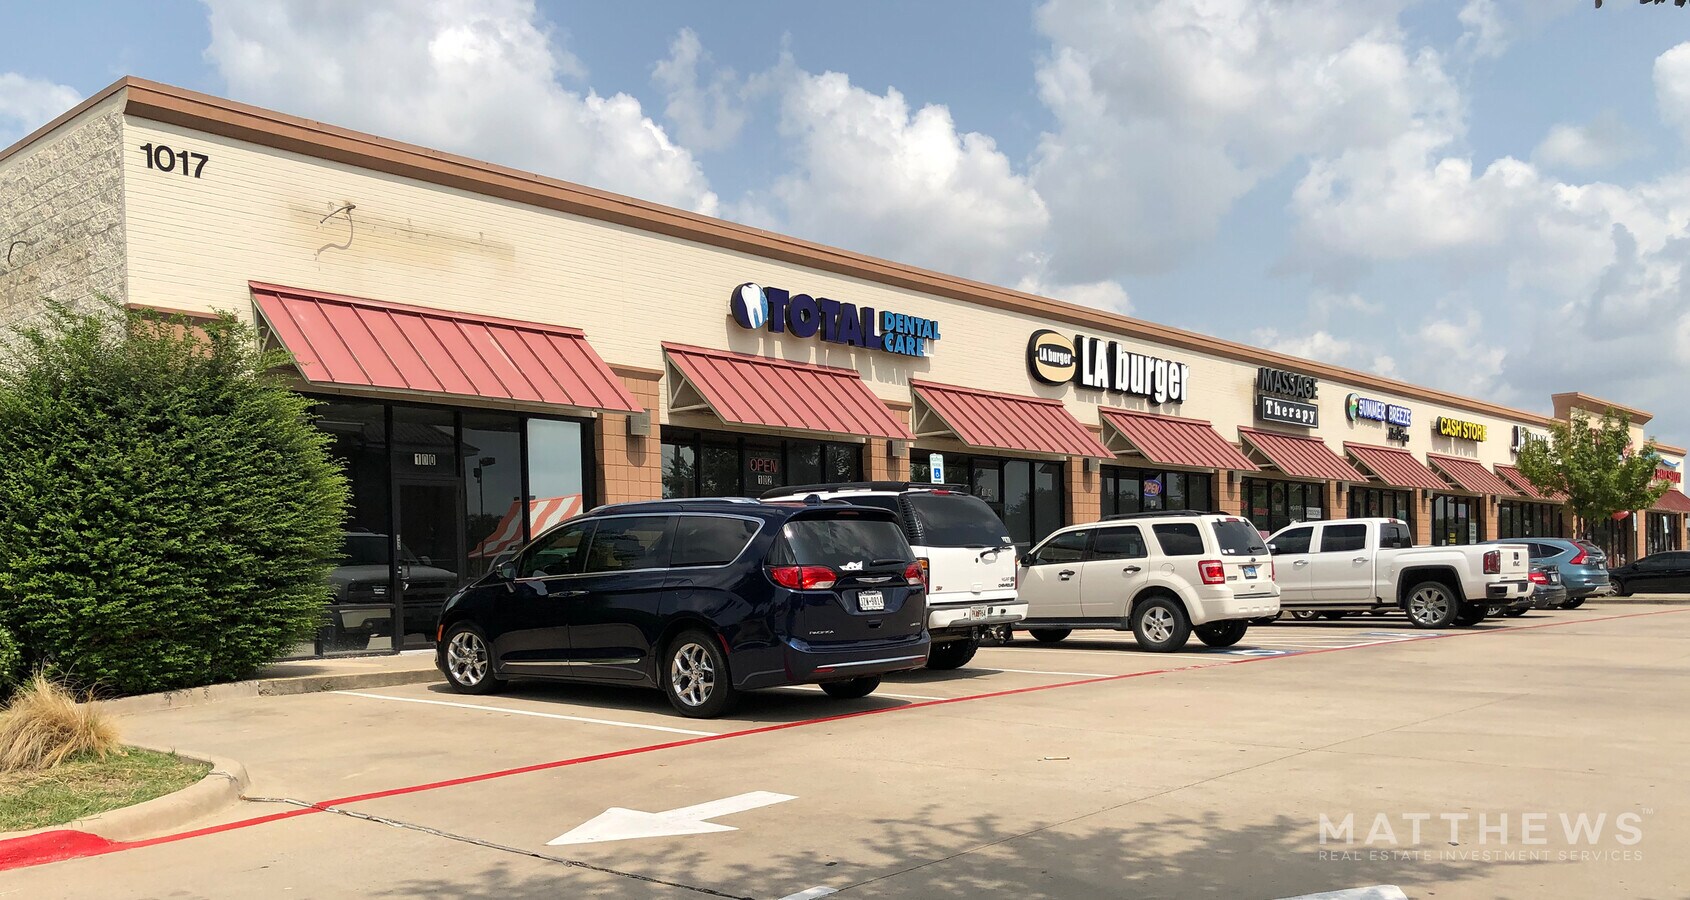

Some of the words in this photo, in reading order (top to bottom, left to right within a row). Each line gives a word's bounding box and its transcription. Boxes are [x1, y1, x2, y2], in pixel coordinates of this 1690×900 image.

[140, 143, 209, 178] 1017
[764, 287, 881, 350] TOTAL
[884, 311, 941, 341] DENTAL
[884, 334, 927, 357] CARE
[1039, 347, 1047, 361] LA
[1048, 349, 1071, 366] burger
[1081, 336, 1109, 388] LA
[1115, 343, 1190, 403] burger
[1260, 367, 1318, 399] MASSAGE
[1265, 400, 1316, 424] Therapy
[1358, 398, 1386, 421] SUMMER
[1388, 404, 1411, 427] BREEZE
[1440, 417, 1462, 438] CASH
[1463, 422, 1487, 442] STORE
[414, 453, 436, 466] 100
[749, 458, 777, 472] OPEN
